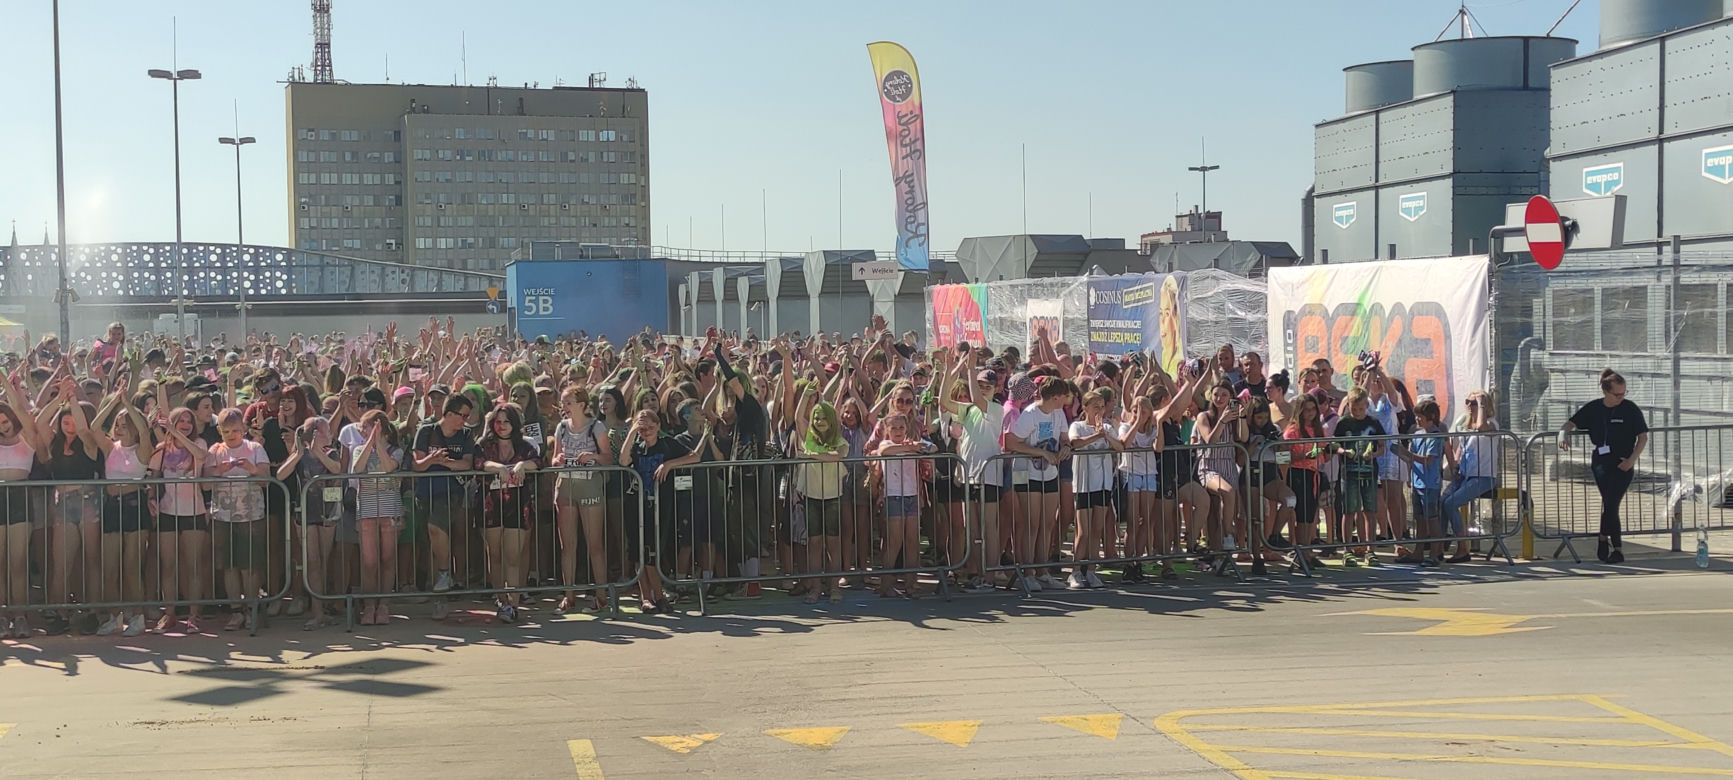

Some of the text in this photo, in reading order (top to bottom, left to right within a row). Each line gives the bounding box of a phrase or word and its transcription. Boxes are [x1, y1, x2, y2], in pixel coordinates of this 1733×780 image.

[523, 287, 556, 296] WEJŚCIE
[1095, 290, 1122, 305] COSINUS
[523, 295, 554, 316] 5B
